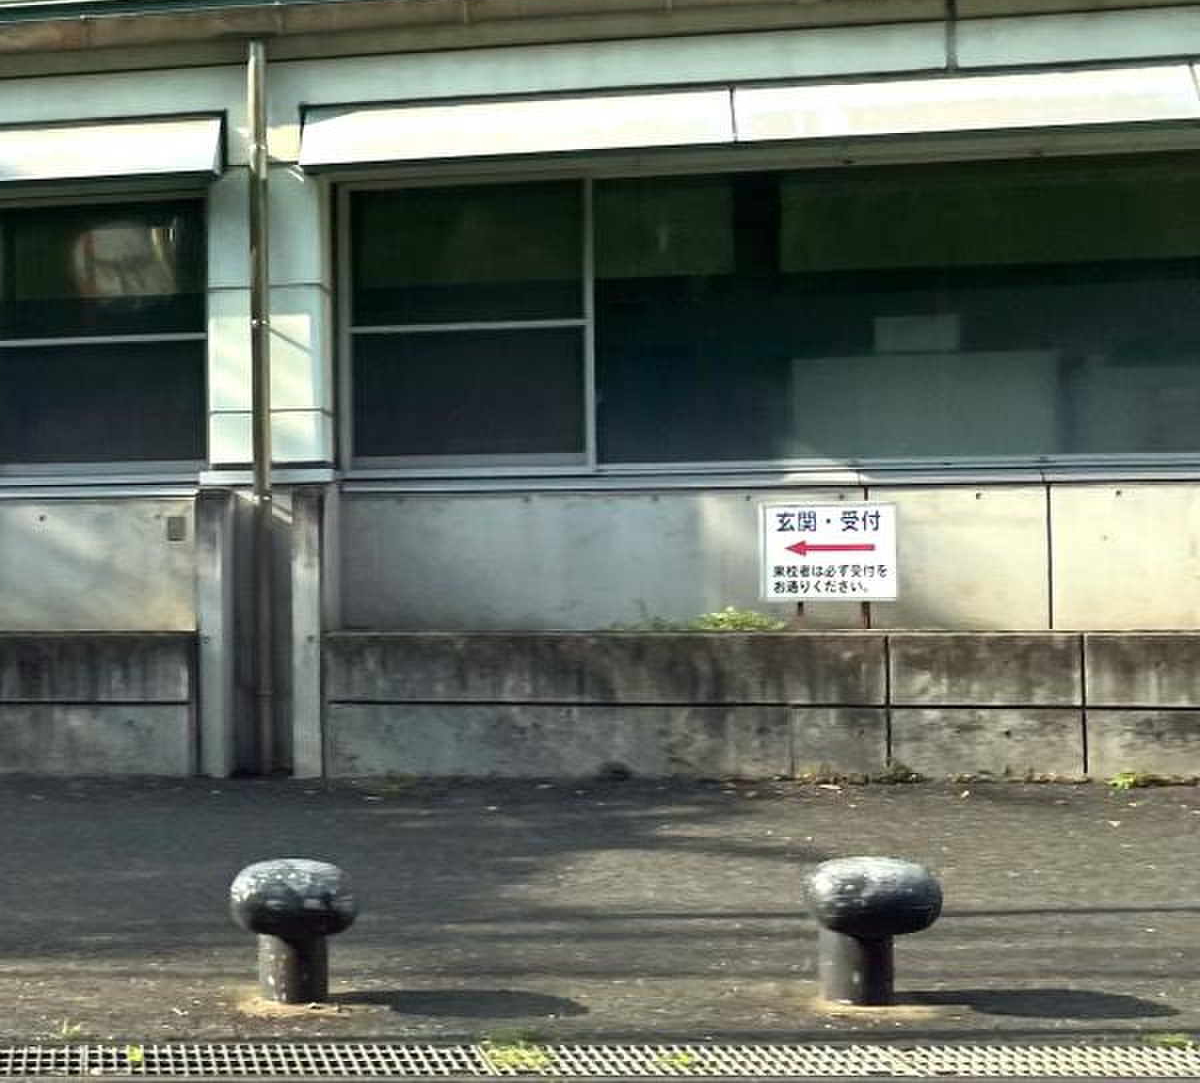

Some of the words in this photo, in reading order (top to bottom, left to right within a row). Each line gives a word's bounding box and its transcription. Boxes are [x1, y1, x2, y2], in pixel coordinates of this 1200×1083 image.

[776, 510, 881, 532] 玄関・受付
